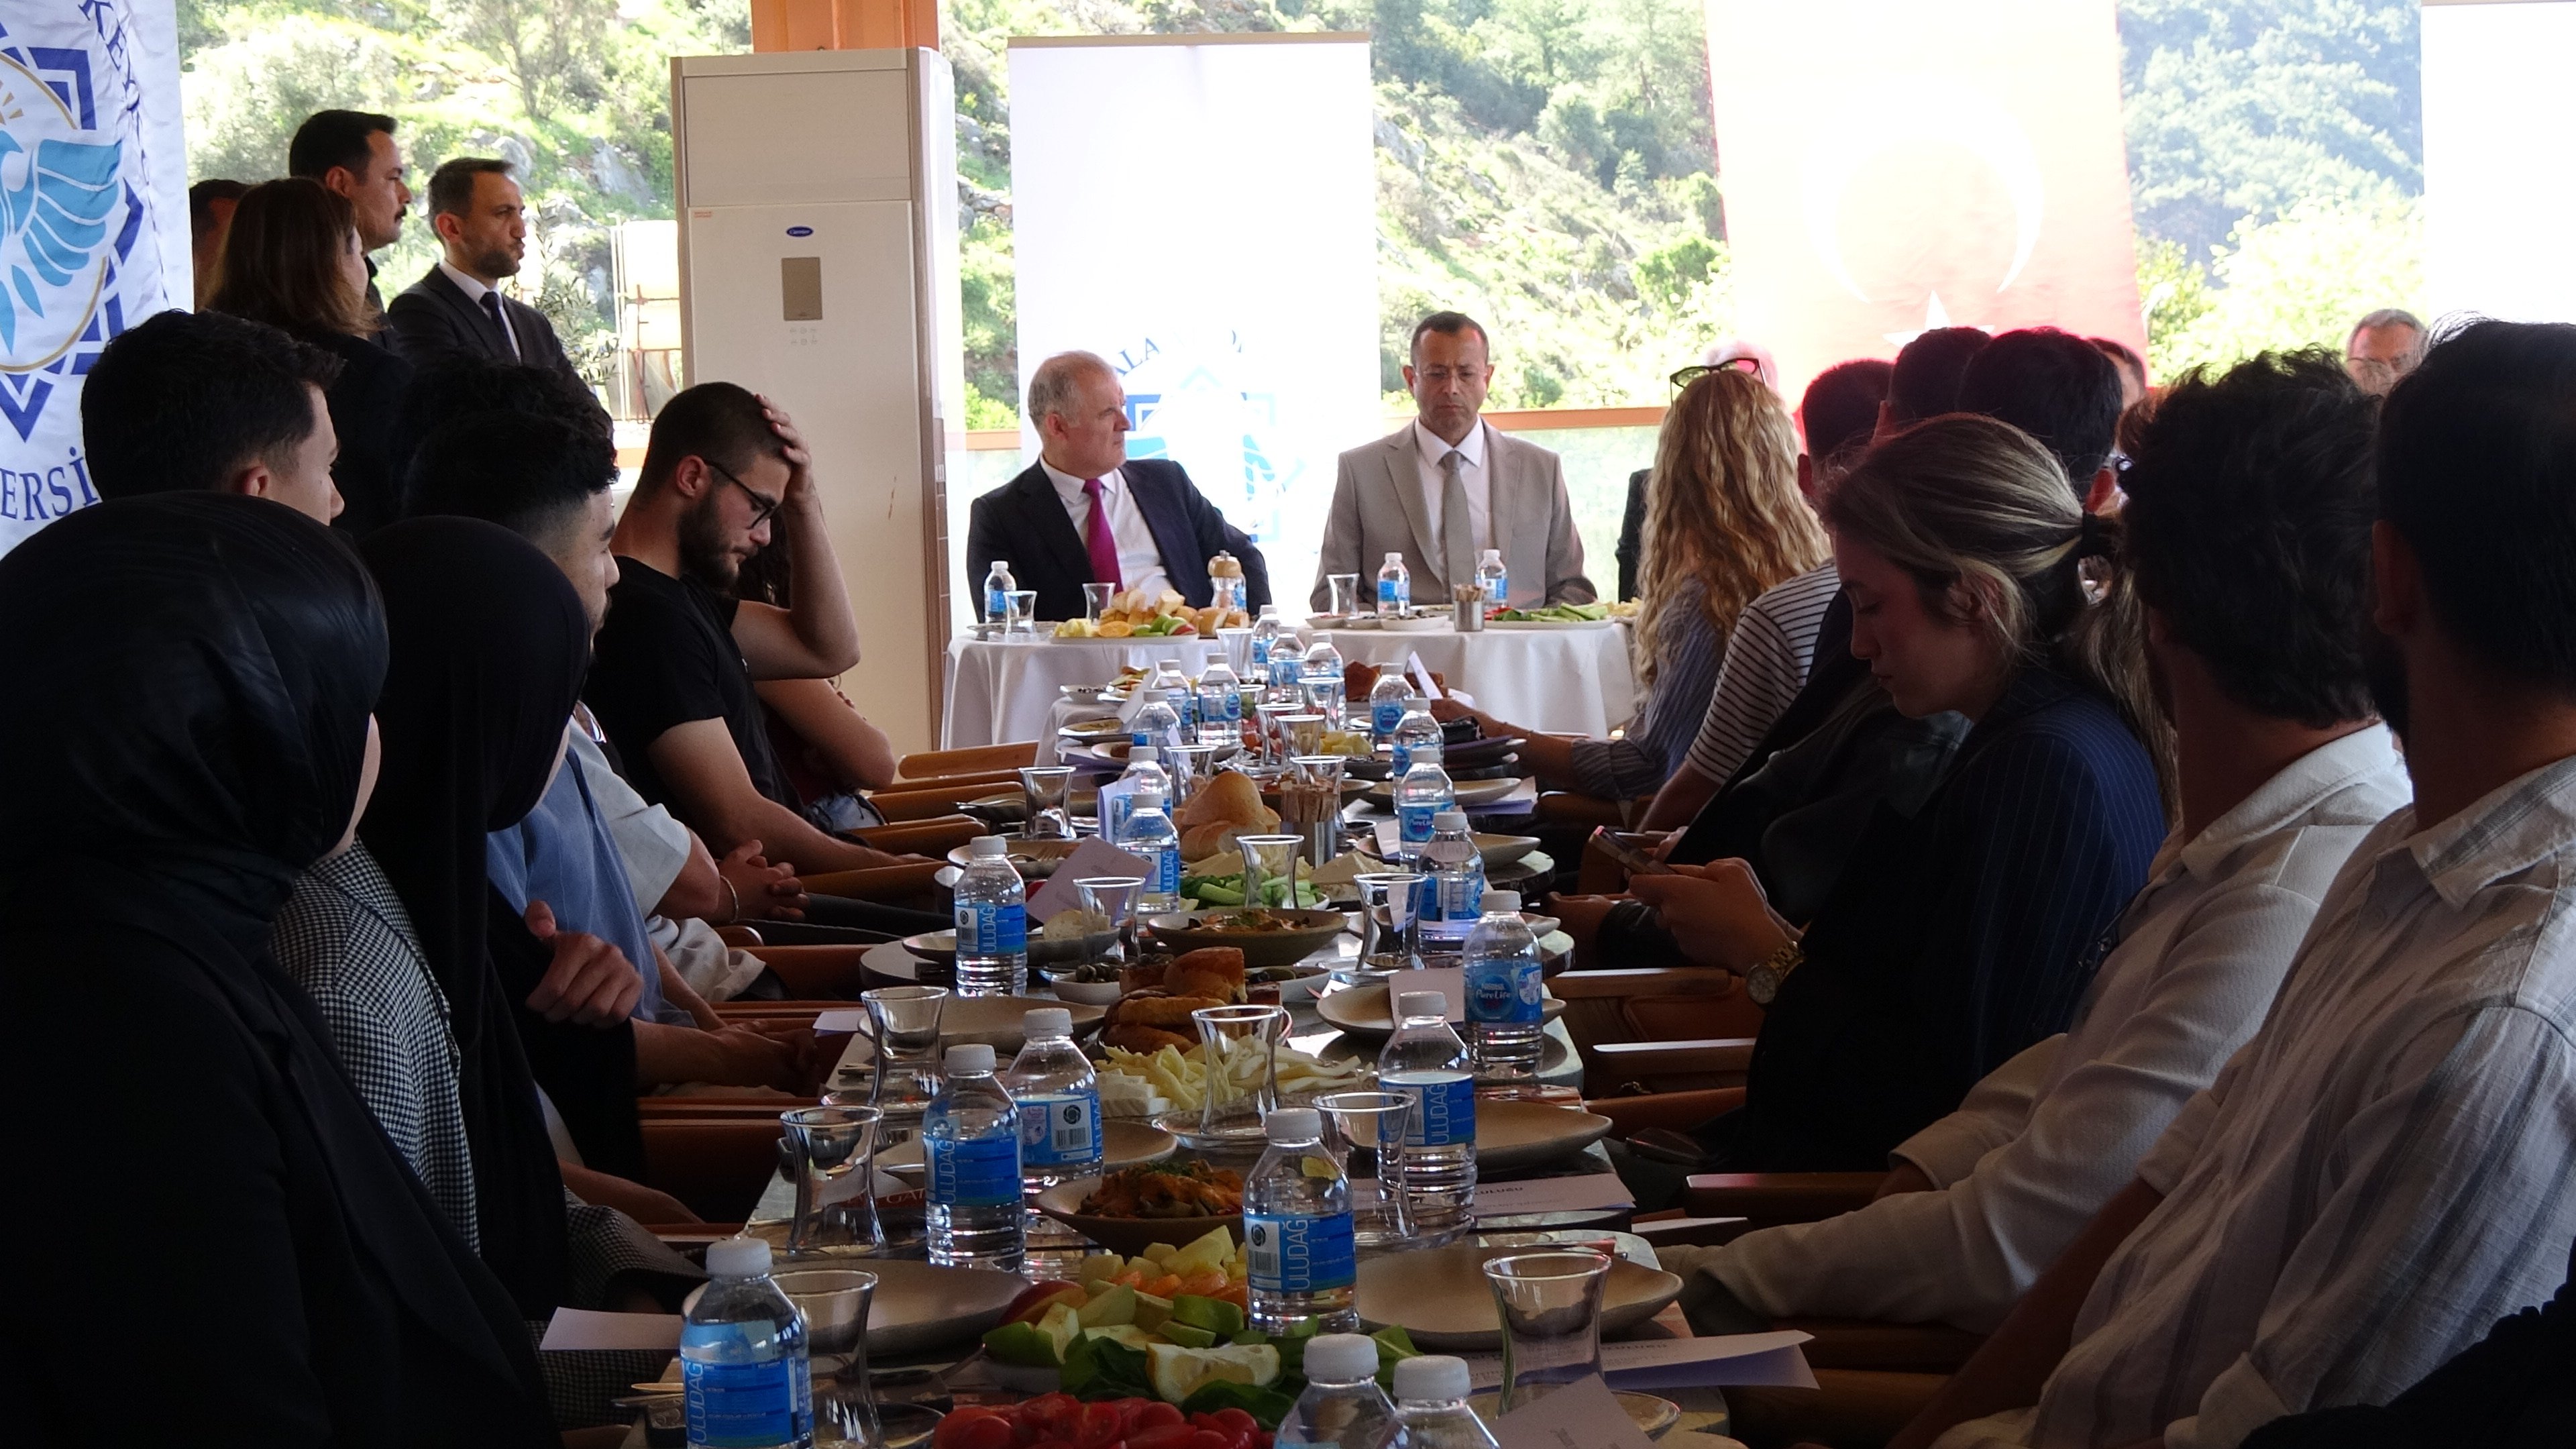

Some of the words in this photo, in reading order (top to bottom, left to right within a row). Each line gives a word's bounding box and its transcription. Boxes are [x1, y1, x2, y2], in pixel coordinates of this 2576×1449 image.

[979, 906, 997, 953] ULUDAĞ
[1424, 1084, 1450, 1144] ULUDAĞ
[935, 1140, 957, 1203] ULUDAĞ
[1281, 1220, 1310, 1291] ULUDAĞ
